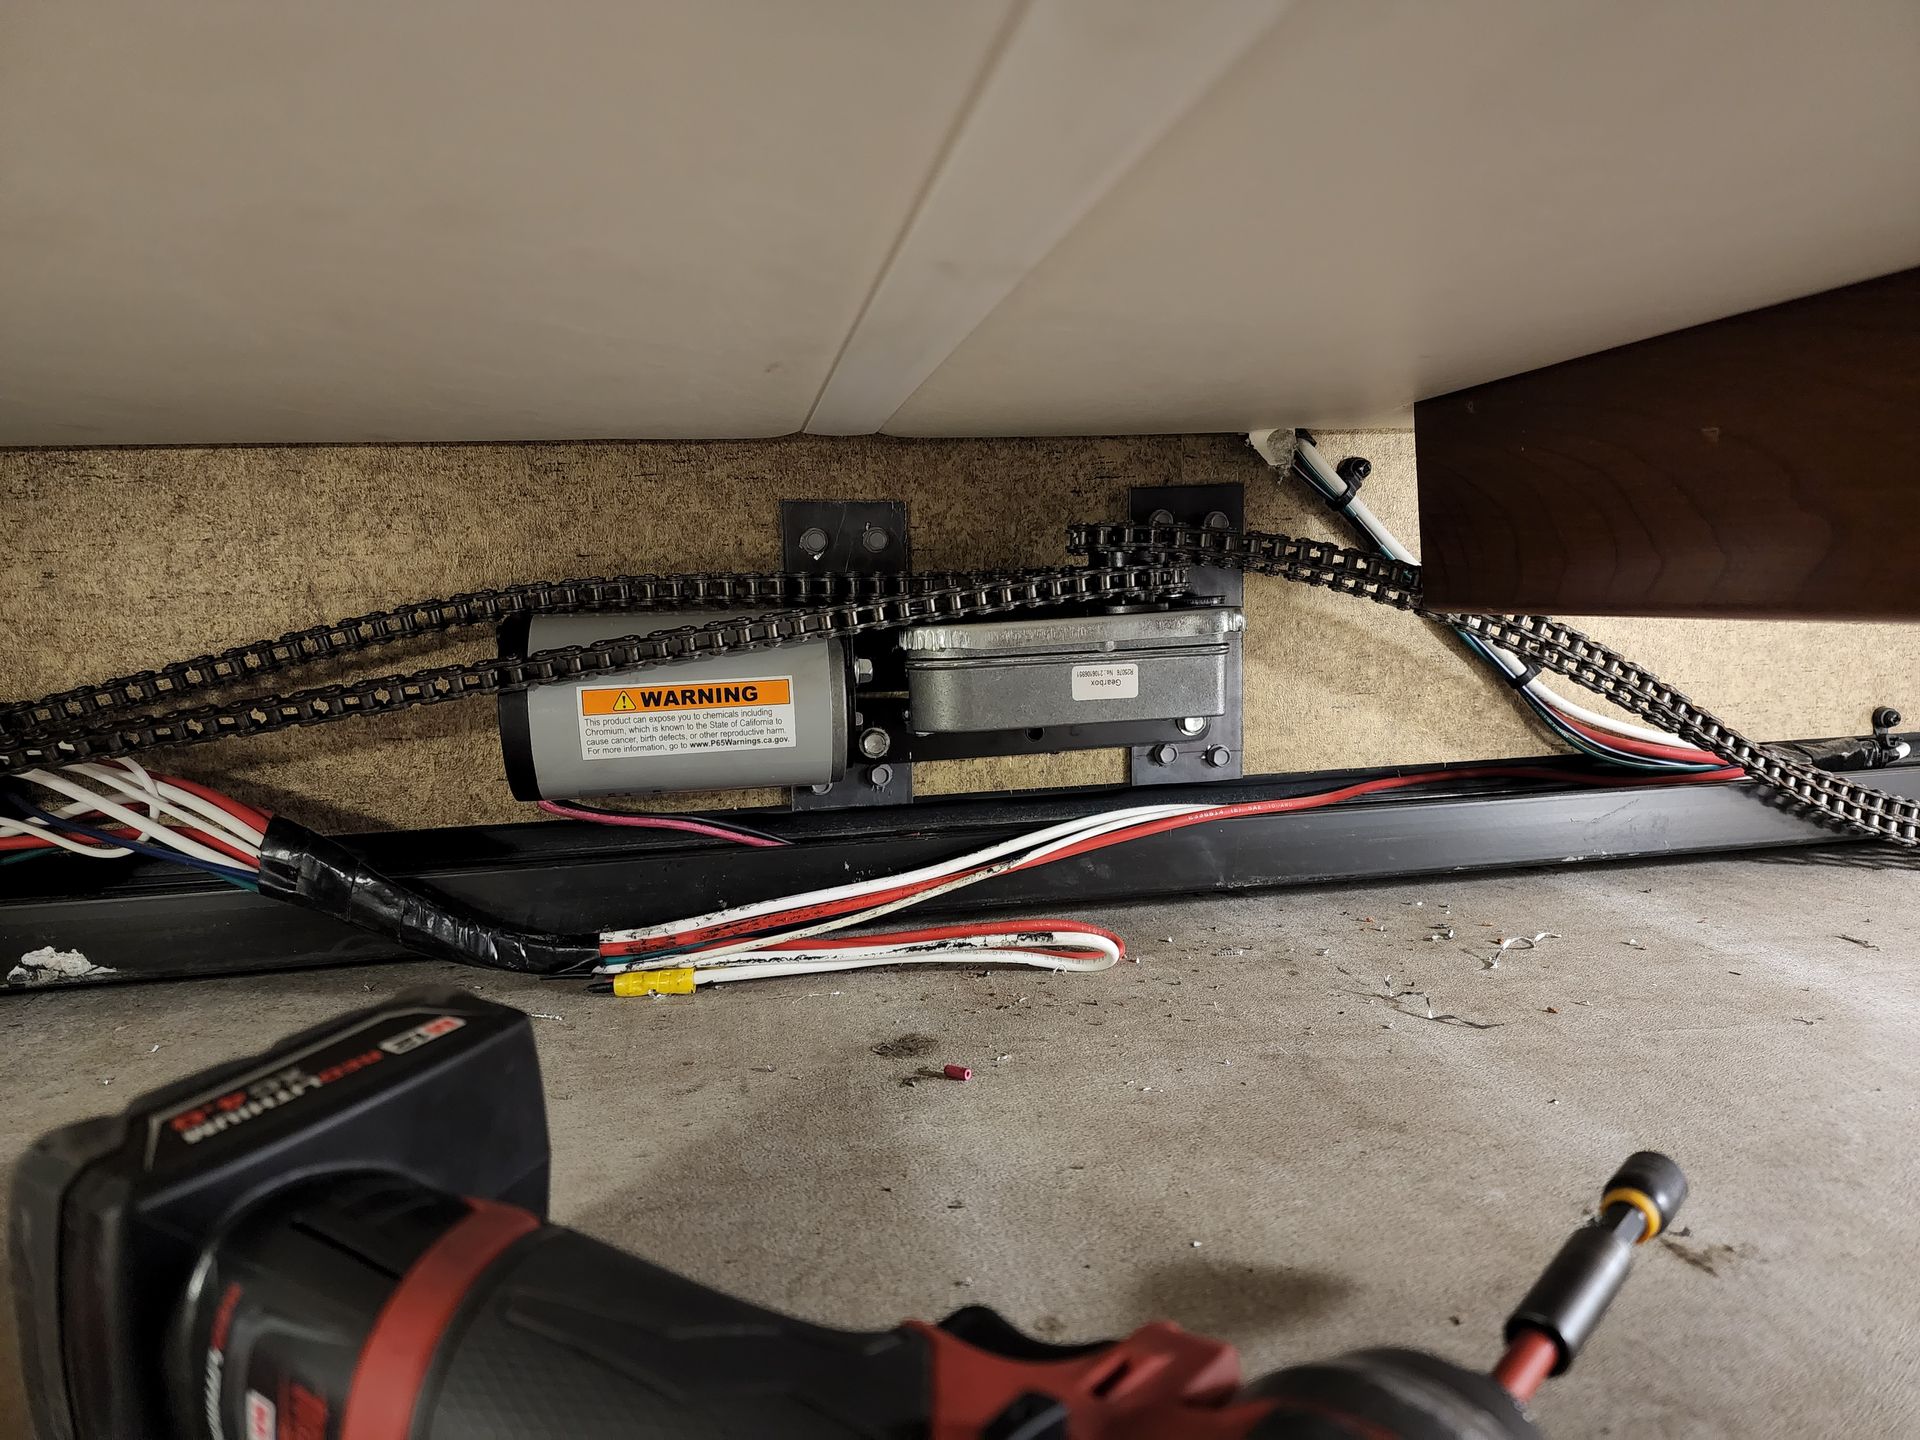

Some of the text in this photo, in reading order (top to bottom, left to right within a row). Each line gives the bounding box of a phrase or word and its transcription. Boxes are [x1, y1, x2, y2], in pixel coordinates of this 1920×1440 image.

[1091, 679, 1122, 687] Gearbox
[640, 686, 758, 708] WARNING
[585, 708, 773, 727] This product can expose you to chemicals including
[585, 727, 627, 737] Chromium,
[628, 725, 650, 734] which
[660, 723, 685, 732] known
[687, 722, 694, 730] to
[696, 721, 708, 729] the
[709, 720, 729, 729] State
[730, 719, 738, 727] of
[740, 717, 774, 726] California
[775, 717, 783, 725] to
[586, 738, 609, 746] cause
[610, 737, 638, 745] cancer,
[640, 734, 657, 743] birth
[659, 733, 687, 741] defects,
[699, 731, 719, 739] other
[720, 728, 765, 738] reproductive
[766, 727, 786, 735] harm.
[587, 747, 601, 755] For
[623, 743, 667, 752] information,
[669, 743, 679, 751] go
[690, 736, 790, 749] www.P65Warnings.ca.gov.
